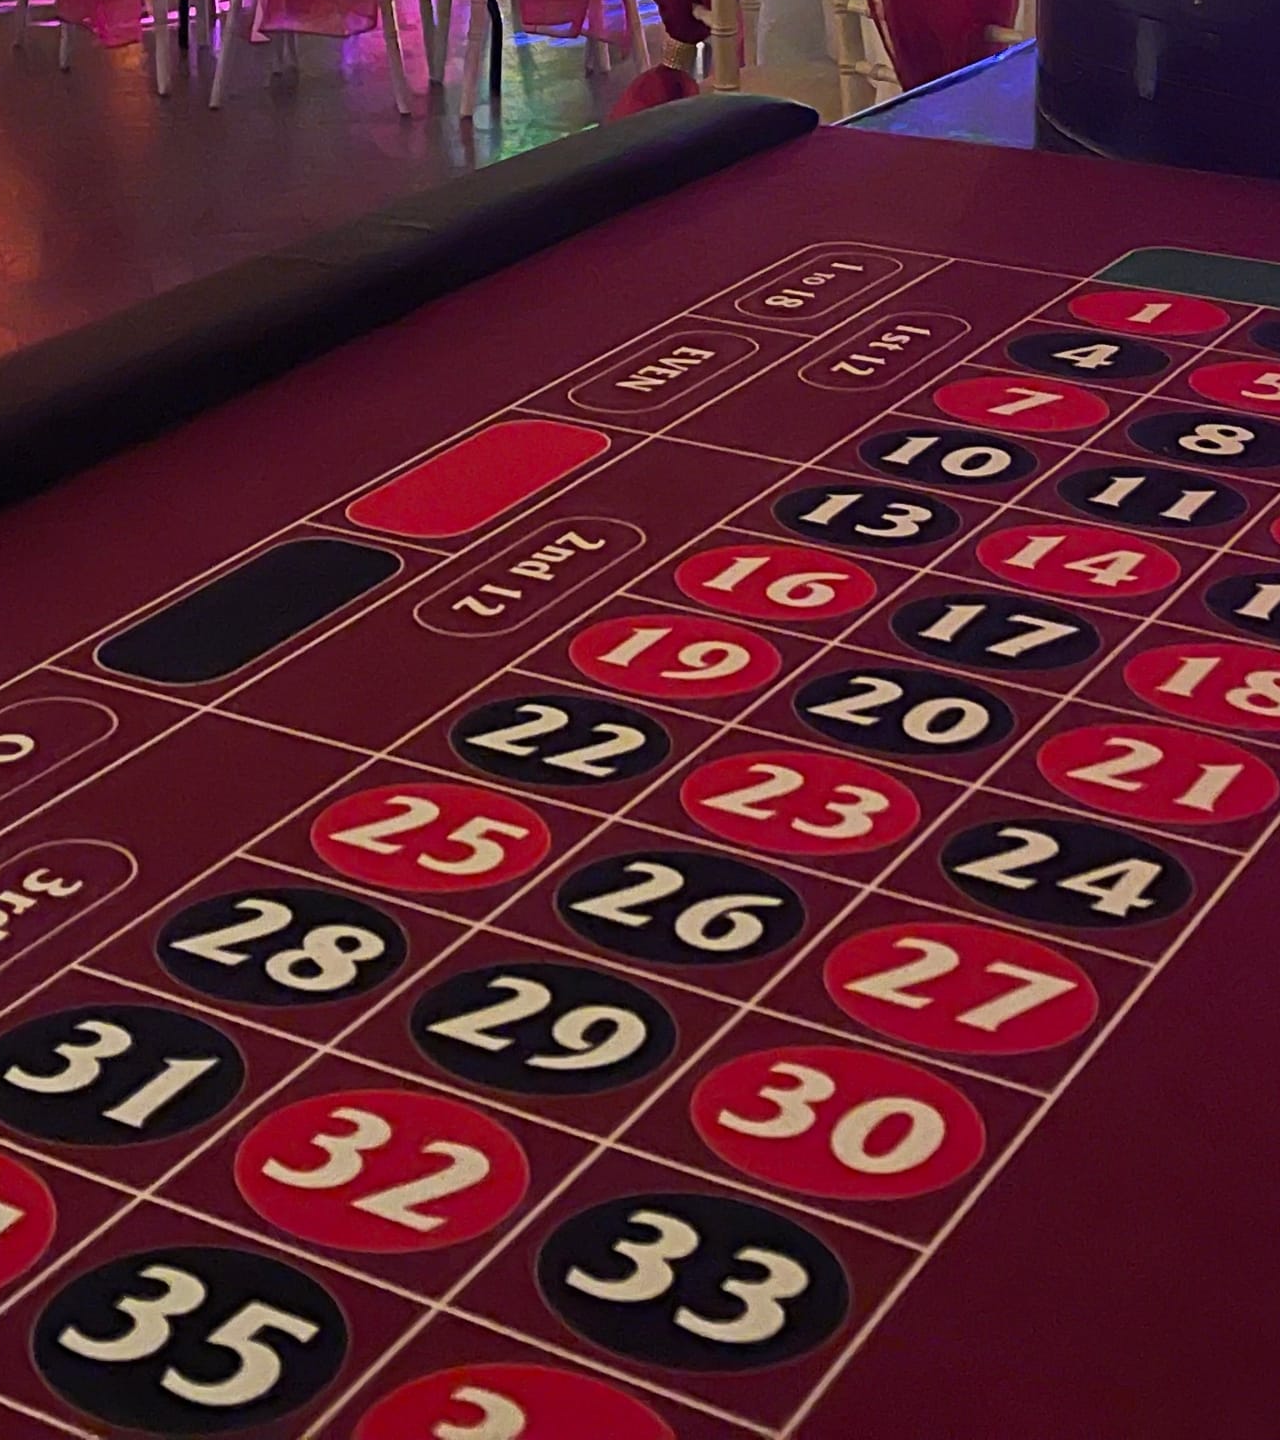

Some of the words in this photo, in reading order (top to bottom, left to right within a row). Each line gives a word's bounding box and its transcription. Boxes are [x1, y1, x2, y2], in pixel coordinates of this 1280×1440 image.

[764, 288, 816, 308] 18
[1127, 302, 1173, 324] 1
[614, 345, 716, 393] EVEN
[830, 353, 886, 377] 12
[1052, 342, 1120, 370] 4
[987, 386, 1064, 417] 7
[880, 435, 1013, 478] 10
[1177, 422, 1256, 456] 8
[798, 492, 934, 538] 13
[1088, 475, 1218, 522] 11
[508, 530, 608, 582] 2nd
[701, 555, 850, 608] 16
[1003, 534, 1146, 588] 14
[450, 582, 524, 618] 12
[596, 627, 751, 681] 19
[917, 603, 1080, 658] 17
[806, 675, 990, 745] 20
[465, 703, 647, 778] 22
[700, 762, 890, 840] 23
[1065, 736, 1244, 813] 21
[328, 794, 530, 876] 25
[953, 826, 1163, 918] 24
[569, 860, 784, 952] 26
[169, 897, 386, 992] 28
[843, 936, 1078, 1032] 27
[426, 975, 648, 1071] 29
[2, 1019, 219, 1129] 31
[717, 1061, 946, 1175] 30
[261, 1106, 491, 1232] 32
[565, 1209, 809, 1344] 33
[57, 1264, 320, 1407] 35
